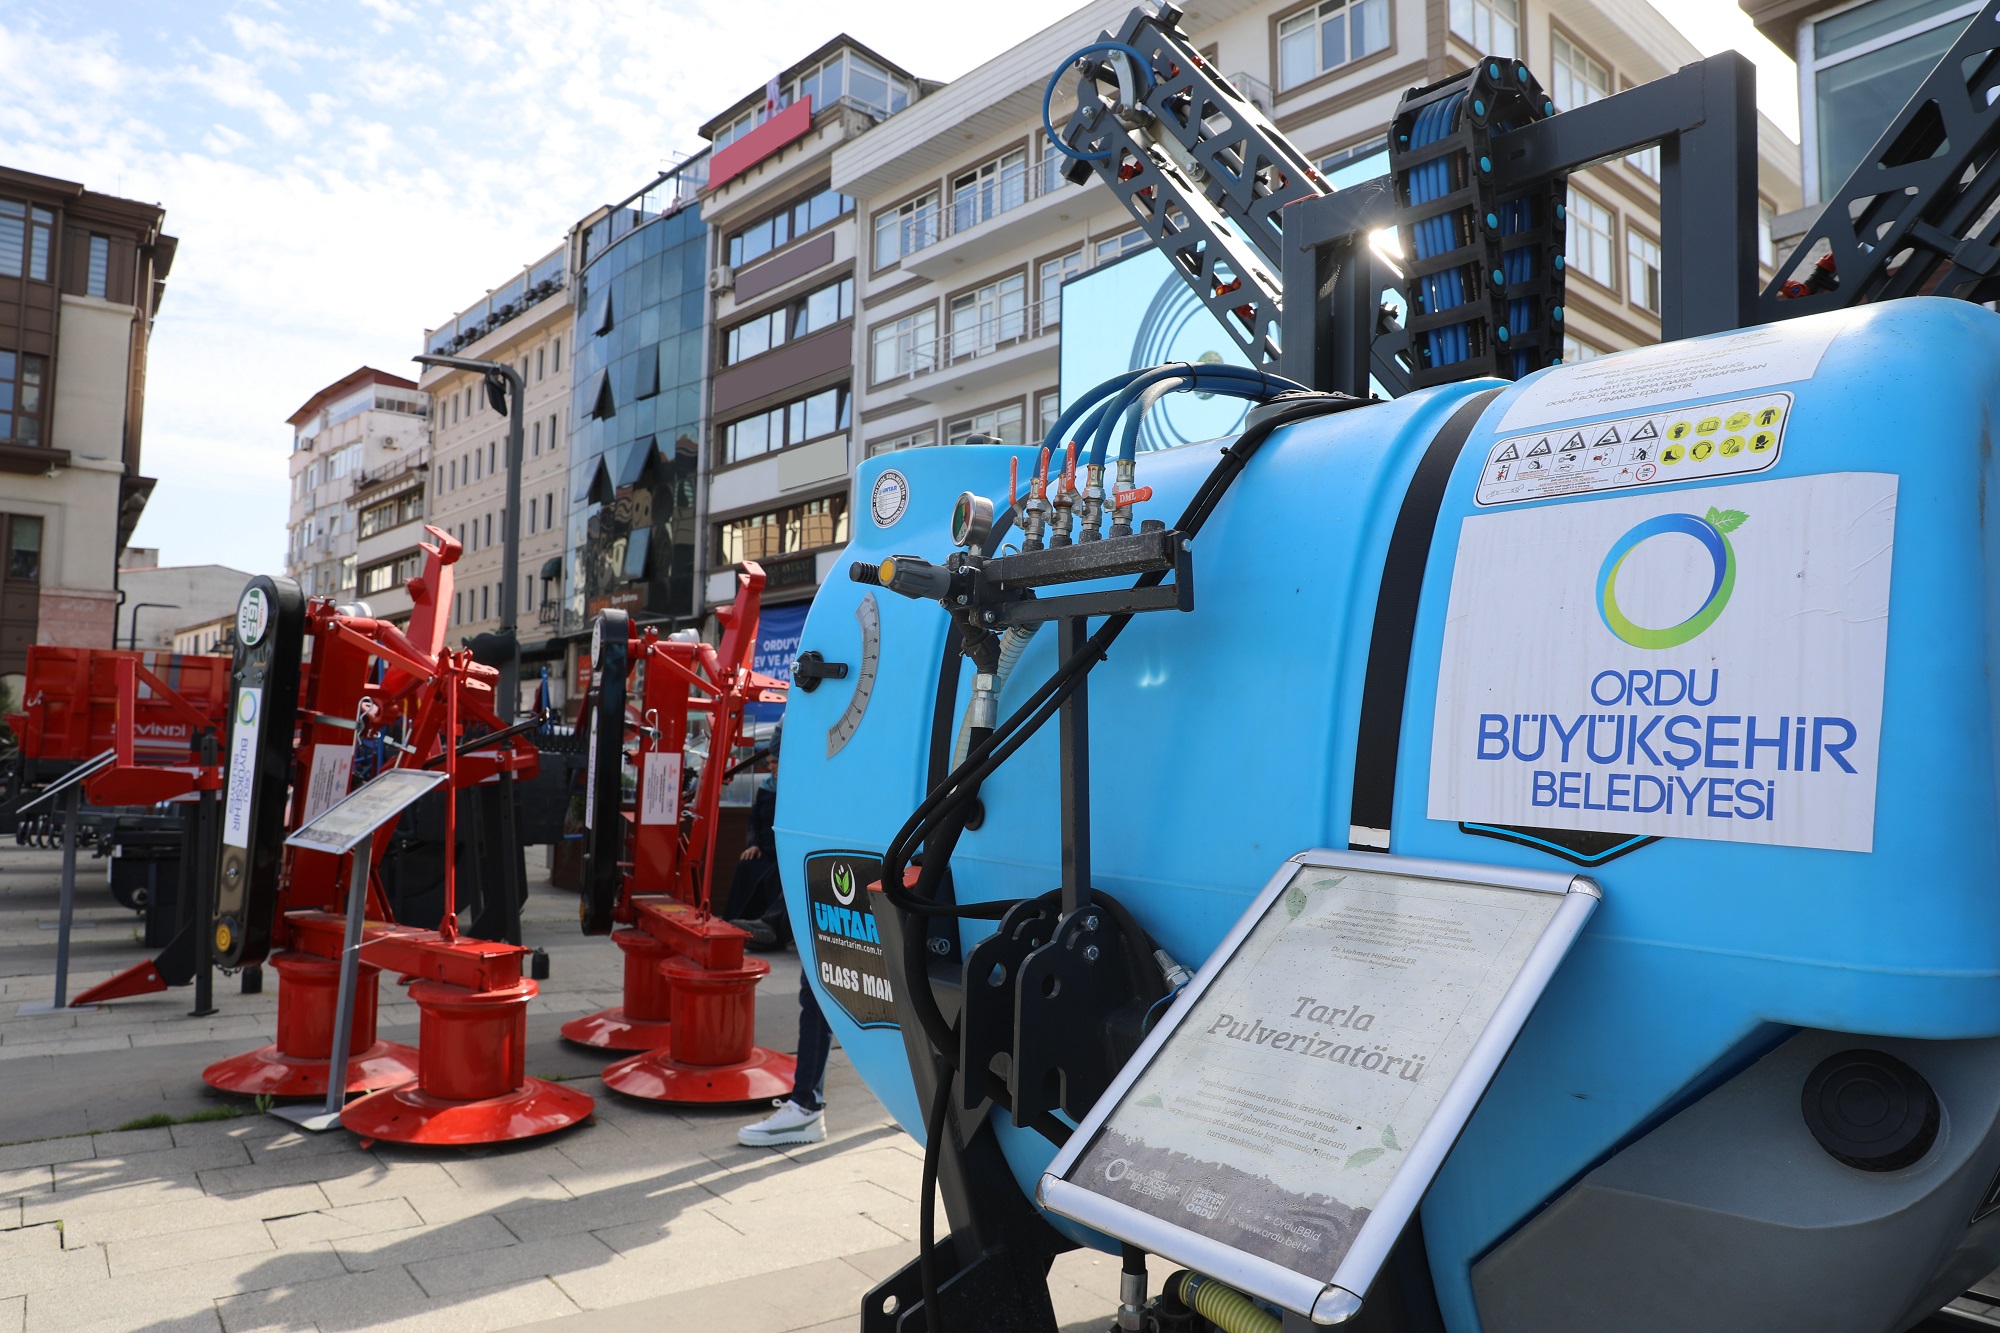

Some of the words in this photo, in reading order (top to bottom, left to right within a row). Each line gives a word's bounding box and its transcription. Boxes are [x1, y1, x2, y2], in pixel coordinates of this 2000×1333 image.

[1120, 492, 1137, 503] DML
[242, 606, 248, 629] cm
[246, 596, 259, 638] 165
[767, 654, 781, 666] VE
[1591, 669, 1719, 706] ORDU
[1476, 714, 1858, 775] BÜYÜKŞEHİR
[1532, 770, 1775, 821] BELEDİYESİ
[818, 933, 883, 956] www.untartarim.com.tr
[1341, 949, 1371, 957] Mehmet
[821, 961, 860, 993] CLASS
[1290, 995, 1376, 1033] Tarla
[1206, 1013, 1427, 1083] Pulverizatörü
[1221, 1109, 1243, 1118] hedef
[1226, 1098, 1267, 1114] yardımıyla
[1267, 1110, 1304, 1124] damlalar
[1303, 1120, 1338, 1135] şeklinde
[1237, 1088, 1266, 1100] konulan
[1298, 1106, 1353, 1124] üzerlerindeki
[1206, 1131, 1227, 1140] tarım
[1212, 1119, 1228, 1127] otla
[1227, 1123, 1263, 1138] mücadele
[1149, 1170, 1168, 1181] ORDU
[1184, 1204, 1215, 1220] ORDU
[1237, 1221, 1311, 1253] www.ordu.bel.tr
